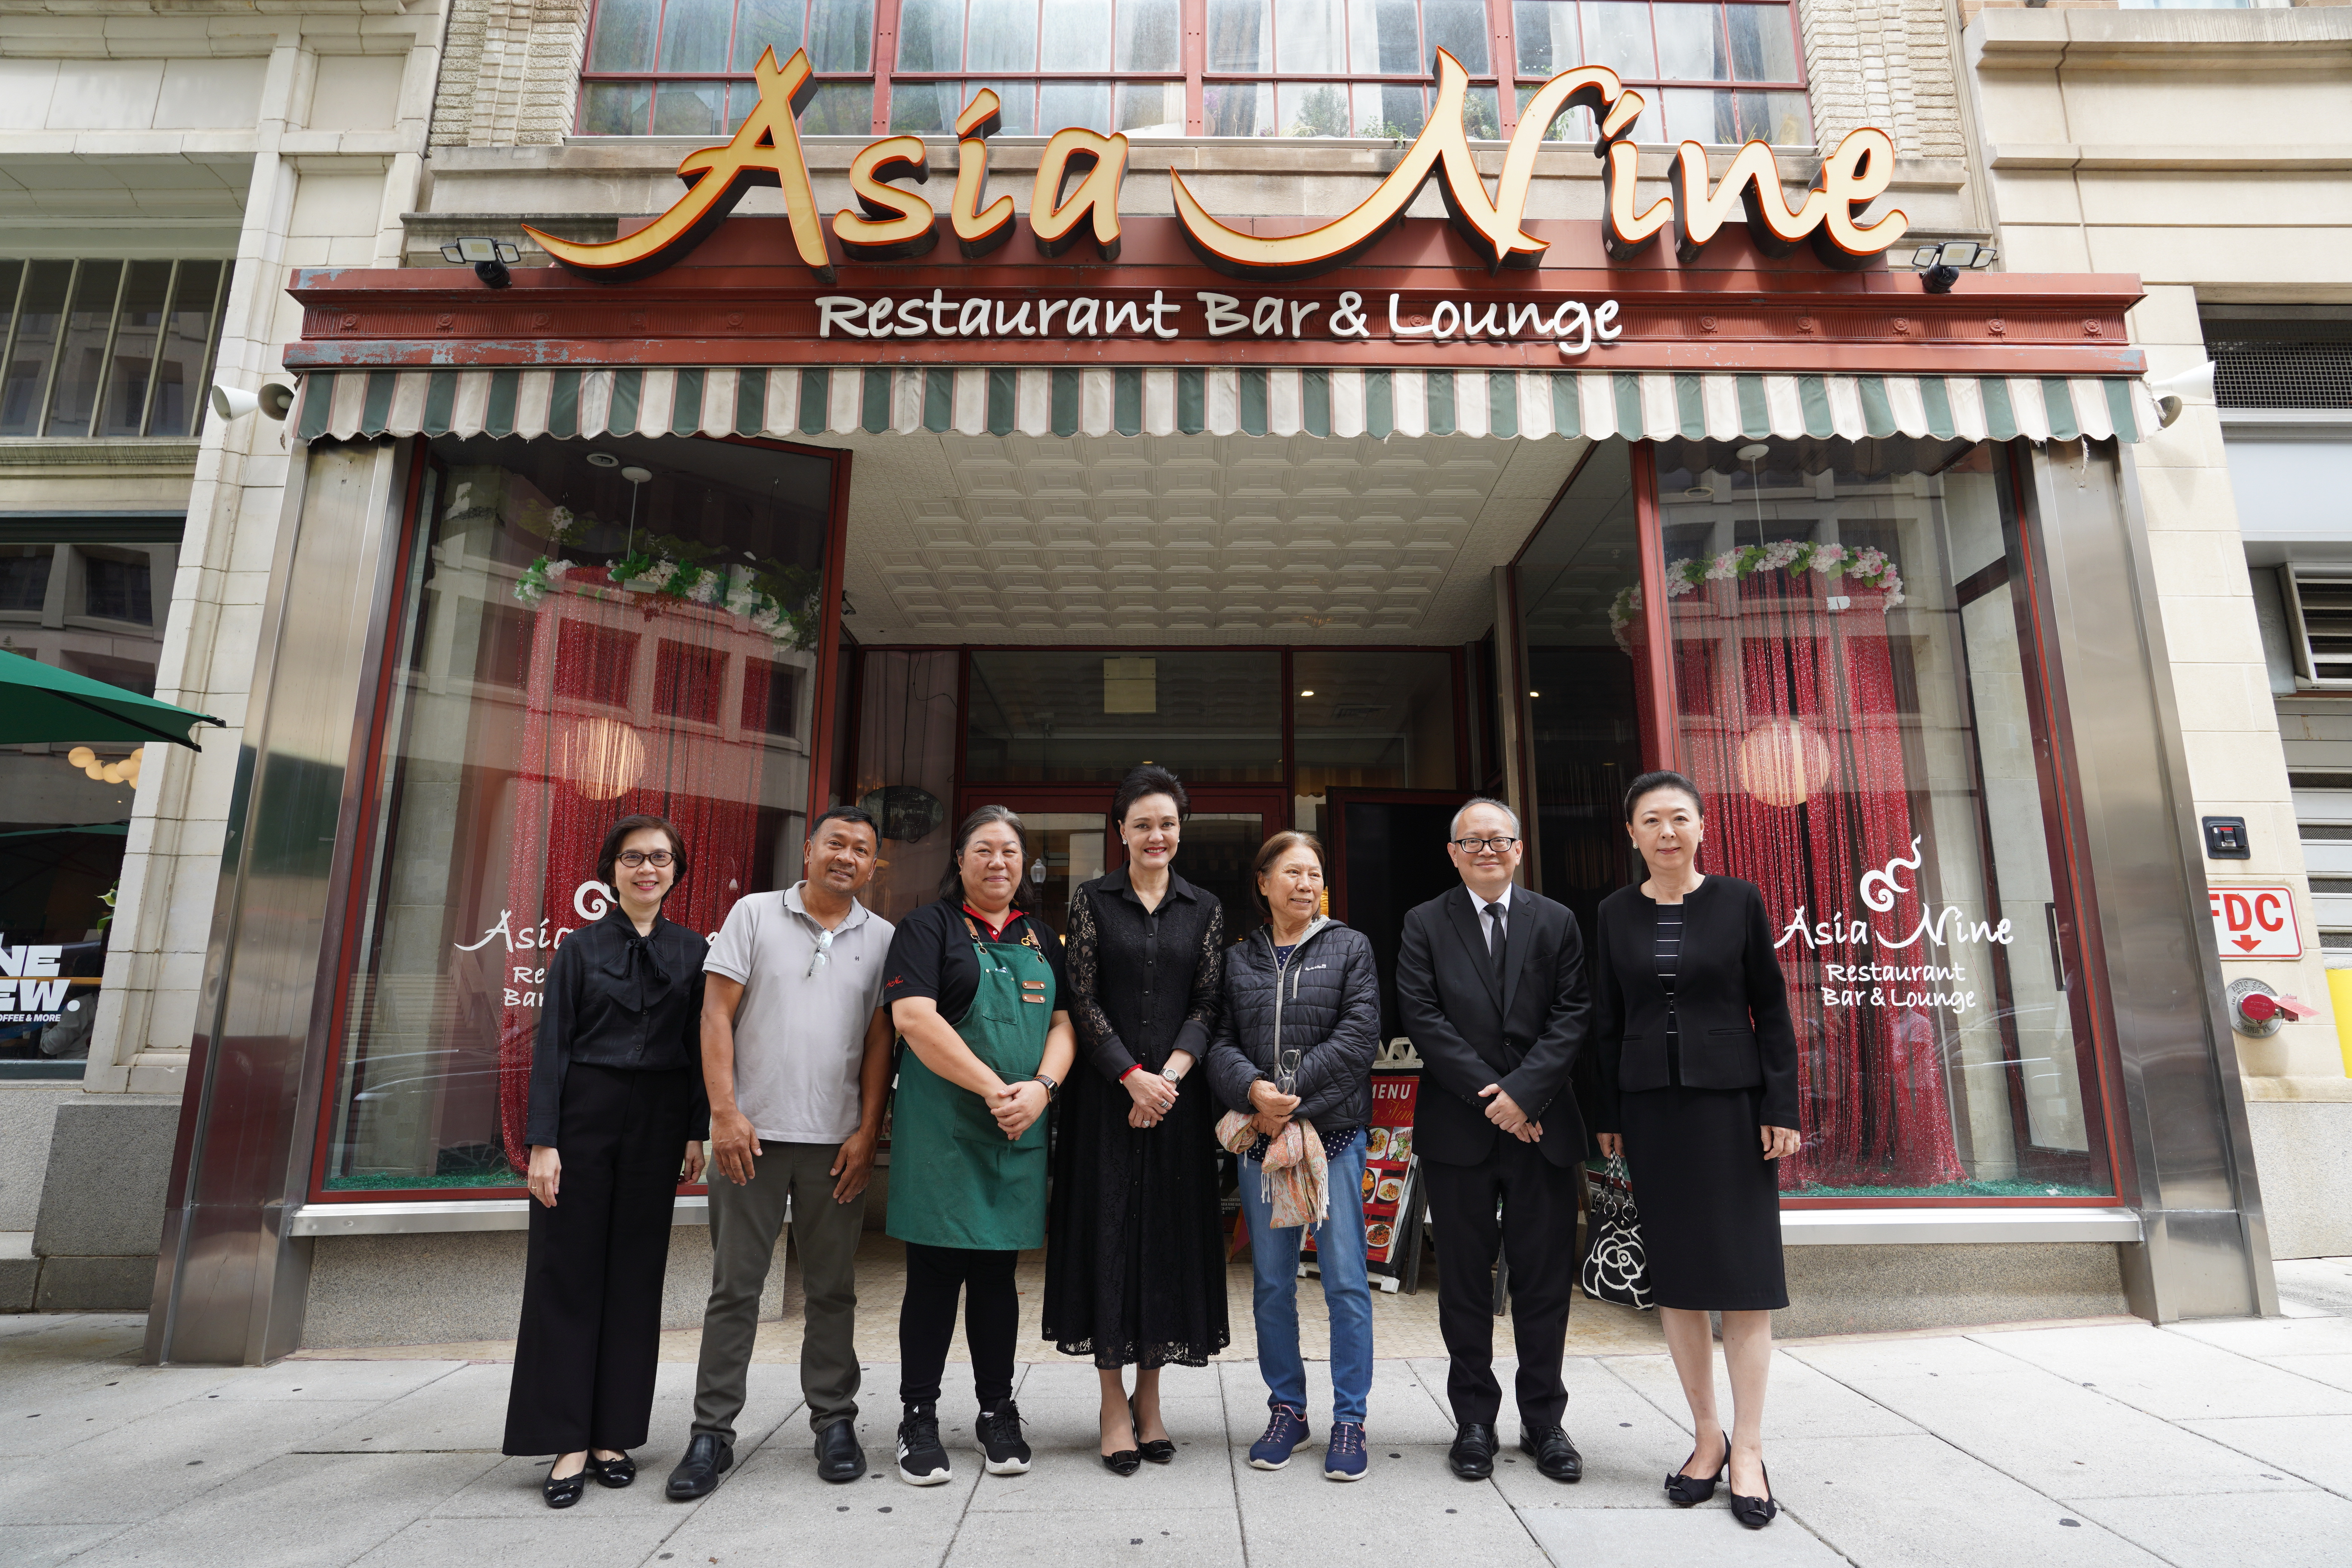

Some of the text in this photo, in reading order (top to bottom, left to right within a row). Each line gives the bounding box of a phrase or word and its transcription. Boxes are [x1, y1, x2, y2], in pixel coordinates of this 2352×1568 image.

[521, 44, 1909, 271] Asia Nine
[815, 288, 1622, 356] Restaurant Bar & Lounge
[1773, 903, 2014, 949] Asia Nine
[1825, 962, 1965, 982] Restaurant
[1821, 987, 1975, 1014] Bar & Lounge
[2235, 1020, 2272, 1034] STANDPPE
